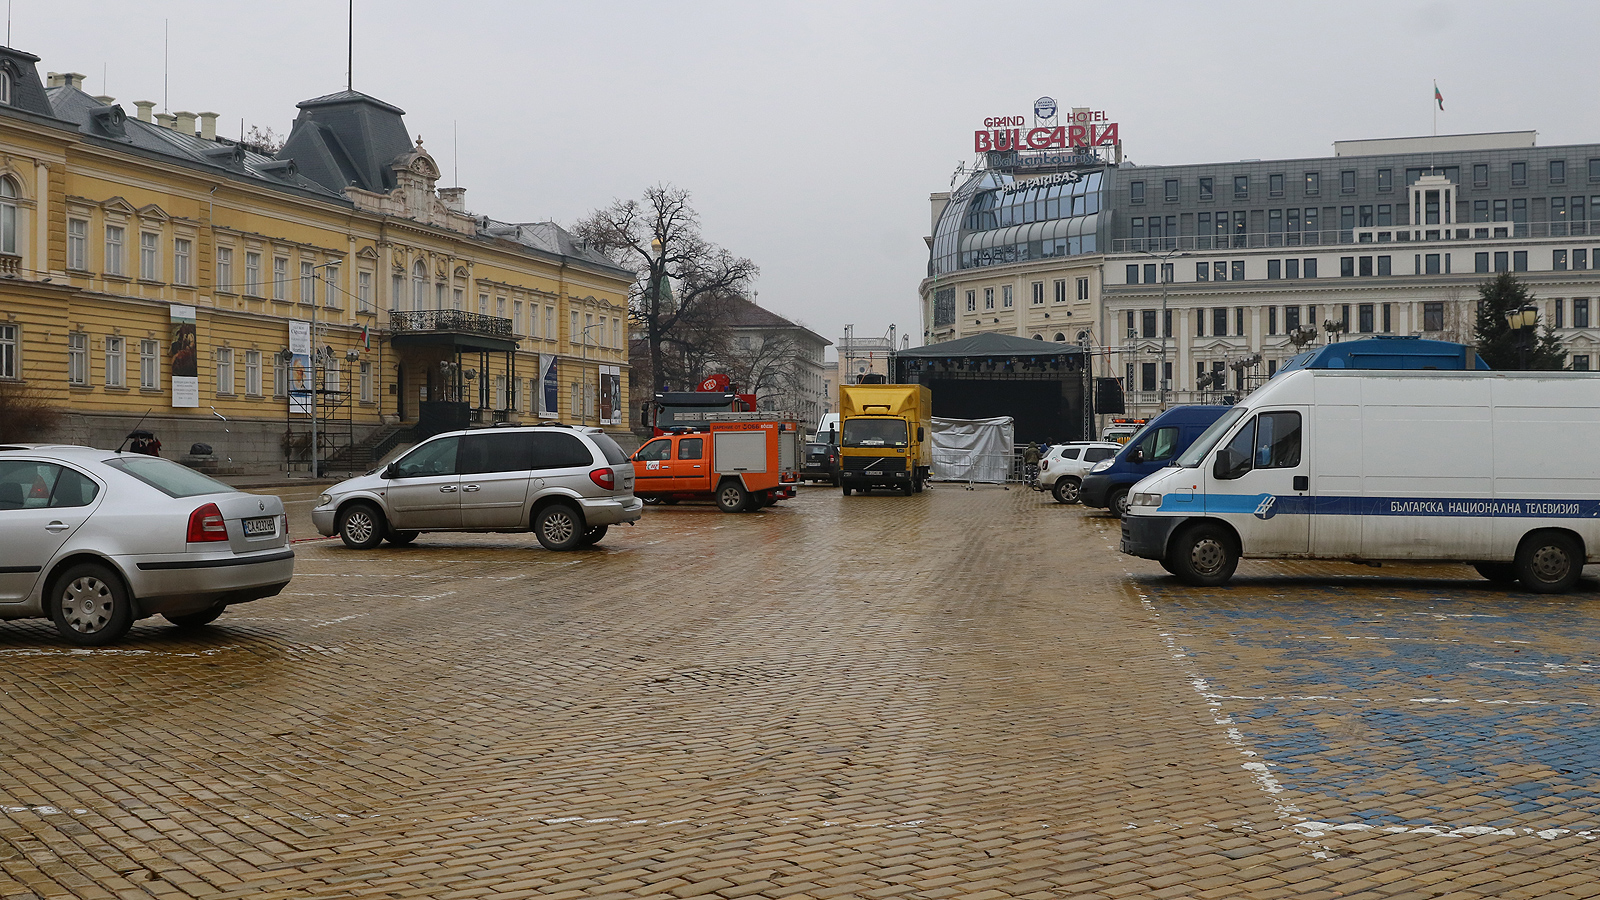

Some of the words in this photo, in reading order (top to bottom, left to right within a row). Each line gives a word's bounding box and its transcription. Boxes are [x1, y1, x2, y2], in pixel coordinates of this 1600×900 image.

[984, 116, 1025, 127] GRAND
[1067, 111, 1108, 122] HOTEL
[975, 123, 1118, 152] BULGARIA
[992, 149, 1101, 167] Balkantourist
[1002, 180, 1025, 193] BNP
[1026, 171, 1078, 187] PARIBAS
[1390, 502, 1444, 512] БЪЛГАРСКА
[1448, 502, 1522, 514] НАЦИОНАЛНА
[1525, 503, 1580, 514] ТЕЛЕВИЗИЯ
